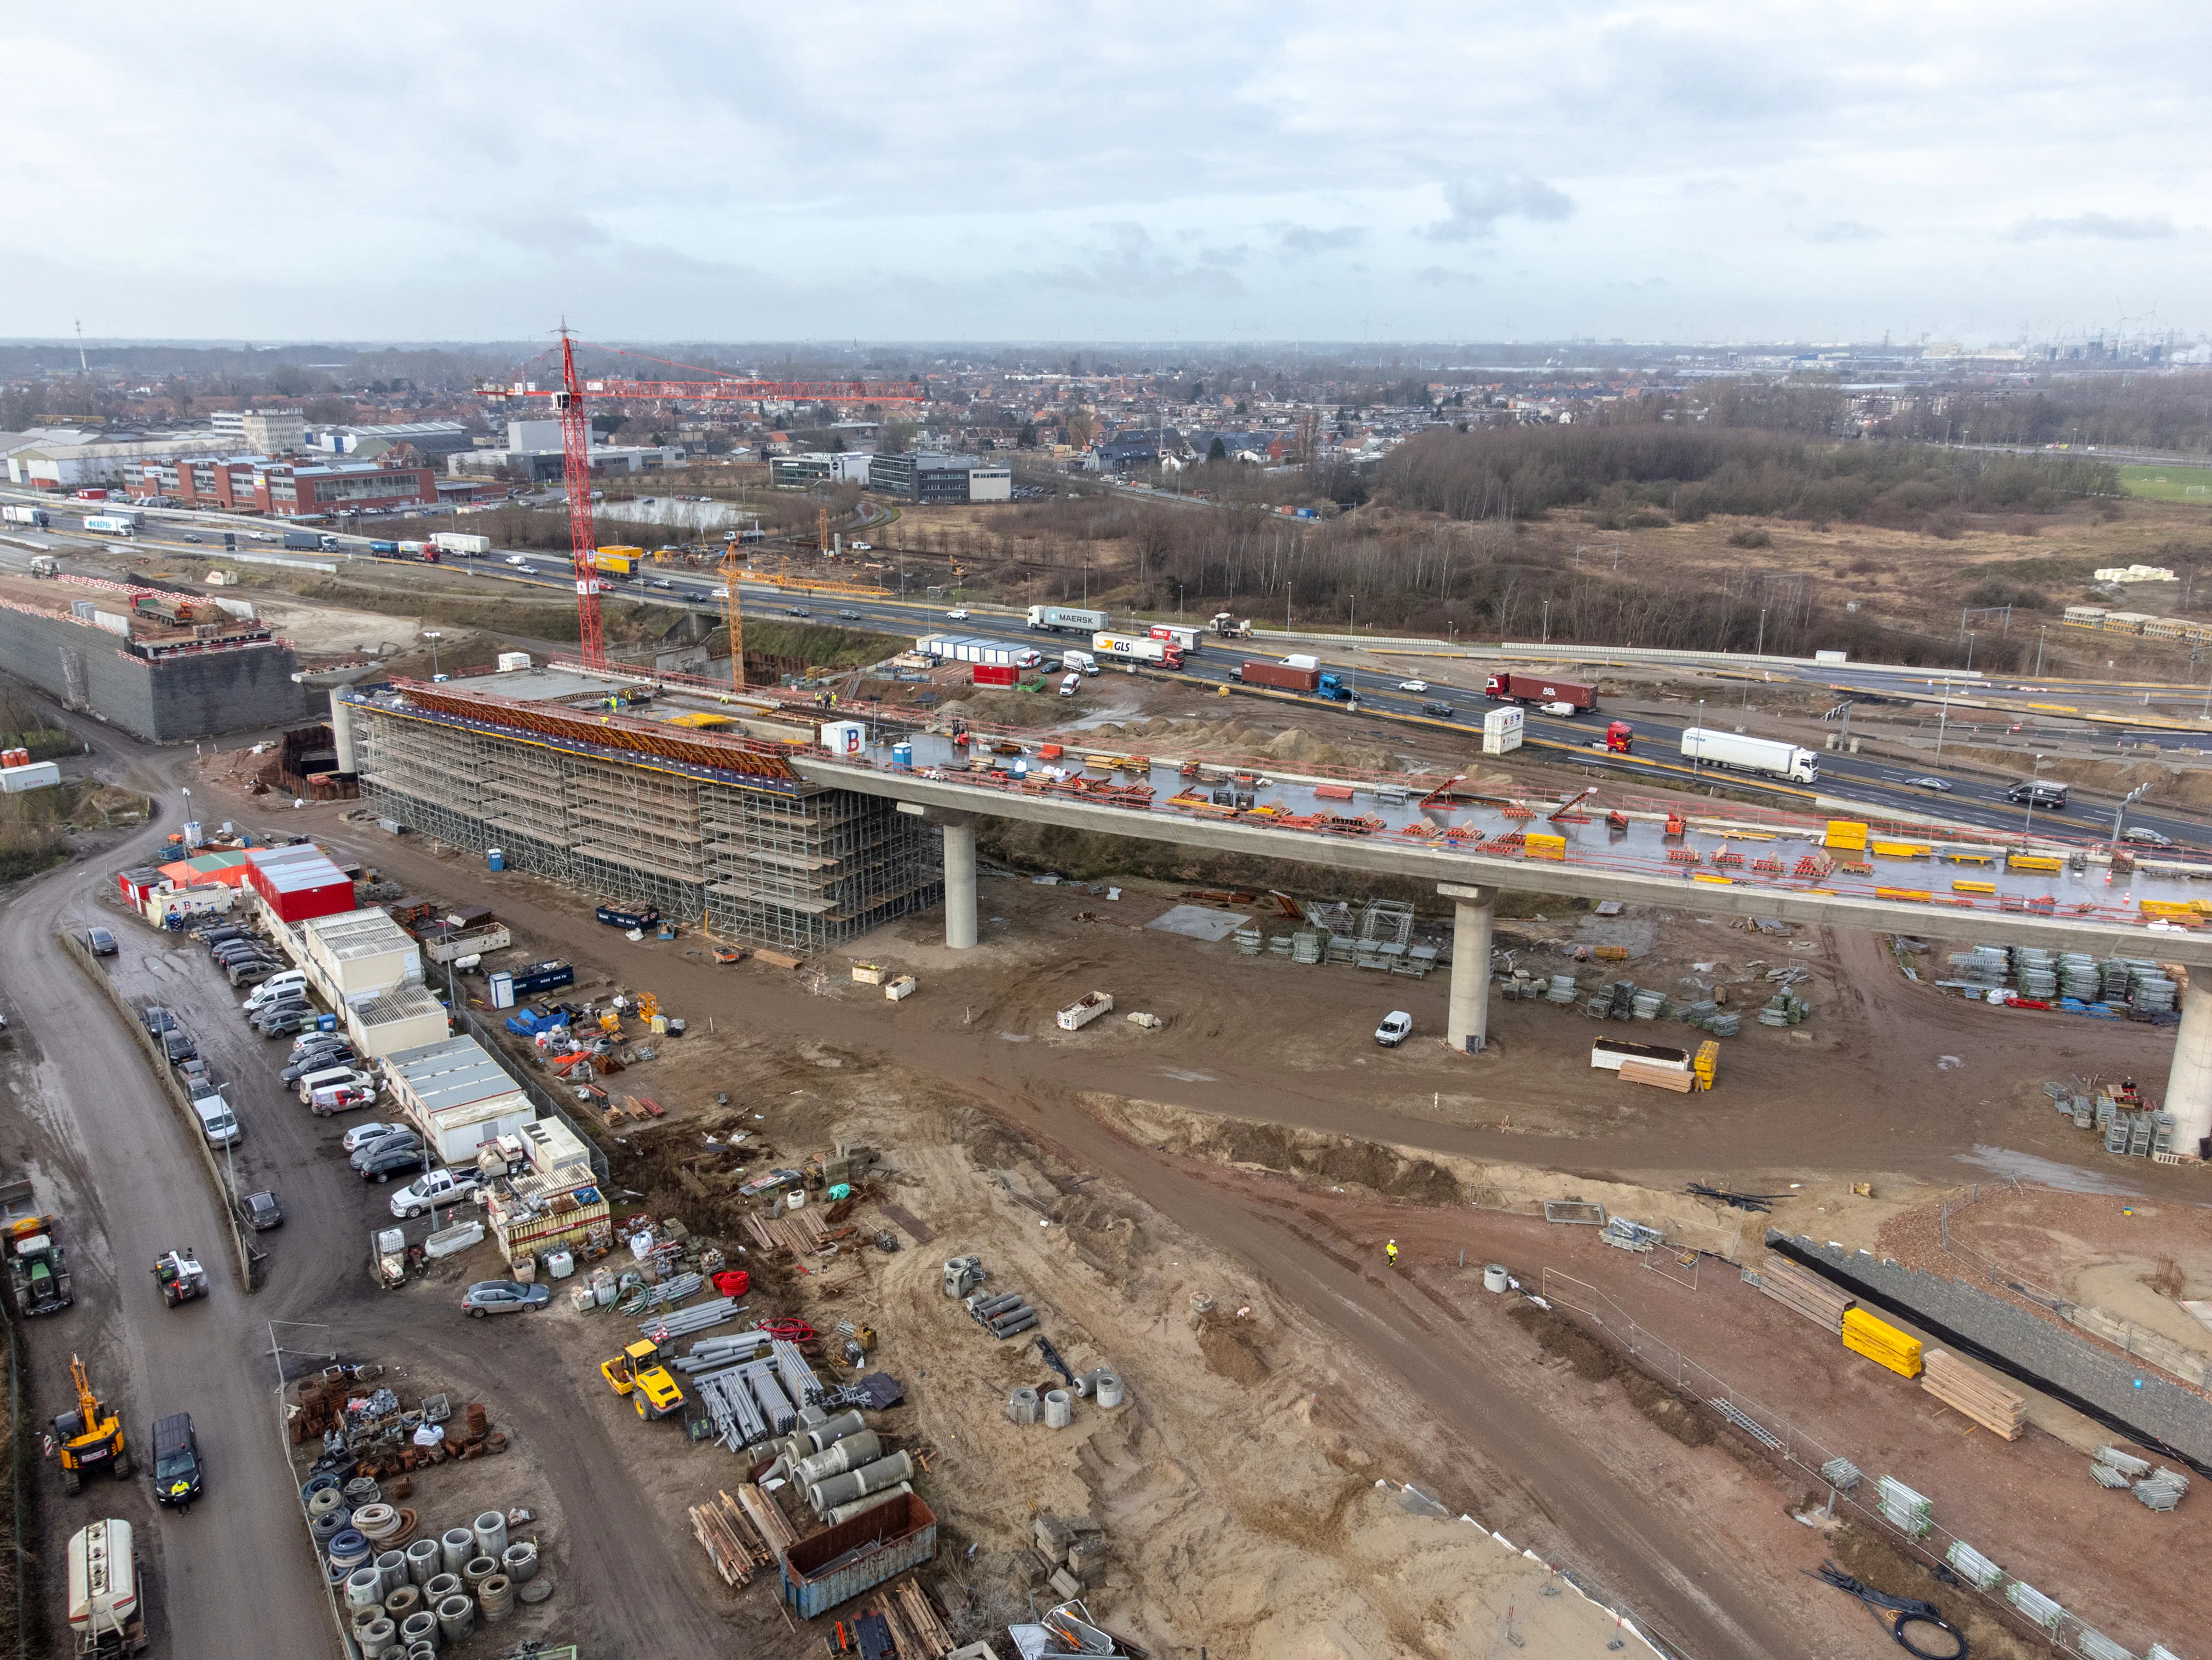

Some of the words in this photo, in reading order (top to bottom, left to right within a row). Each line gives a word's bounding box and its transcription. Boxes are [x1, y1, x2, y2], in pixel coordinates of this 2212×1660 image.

[1059, 614, 1093, 624] MAERSK
[1114, 641, 1130, 652] GLS
[846, 729, 859, 753] B
[183, 901, 191, 910] B
[545, 1224, 575, 1235] STADSBADER
